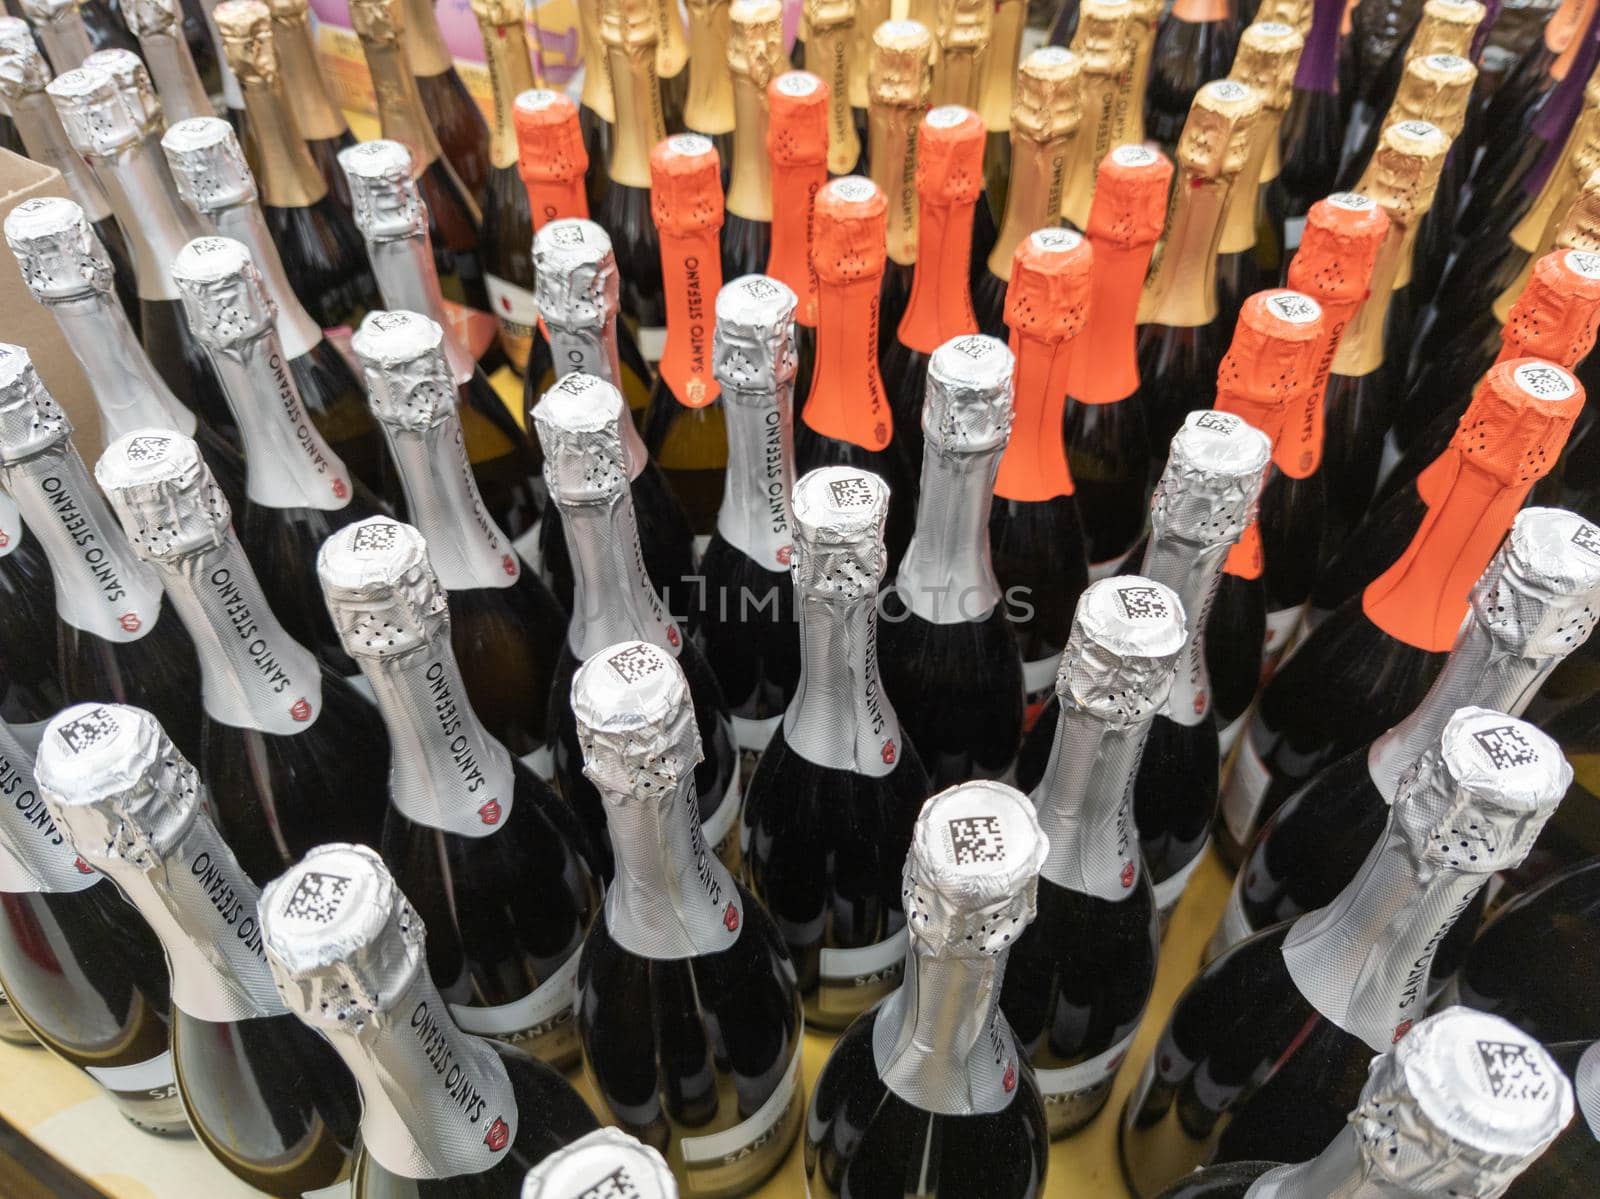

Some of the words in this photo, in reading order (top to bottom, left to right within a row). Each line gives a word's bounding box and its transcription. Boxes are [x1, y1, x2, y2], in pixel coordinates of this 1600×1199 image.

[685, 257, 703, 320] STEFANO
[691, 325, 704, 373] SANTO
[269, 354, 301, 423] STEFANO
[1301, 394, 1318, 443] SANTO
[1312, 322, 1344, 388] STEFANO
[297, 424, 328, 473] SANTO
[766, 411, 781, 479] STEFANO
[42, 477, 94, 546] STEFANO
[768, 482, 787, 533] SANTO
[85, 548, 125, 602] SANTO
[211, 568, 257, 639] STEFANO
[249, 639, 290, 693] SANTO
[426, 662, 461, 736] STEFANO
[865, 681, 884, 735] SANTO
[451, 735, 485, 792] SANTO
[191, 852, 243, 924] STEFANO
[698, 850, 722, 905] SANTO
[237, 917, 267, 962] NTO
[411, 1001, 451, 1074] STEFANO
[445, 1063, 486, 1123] SANTO
